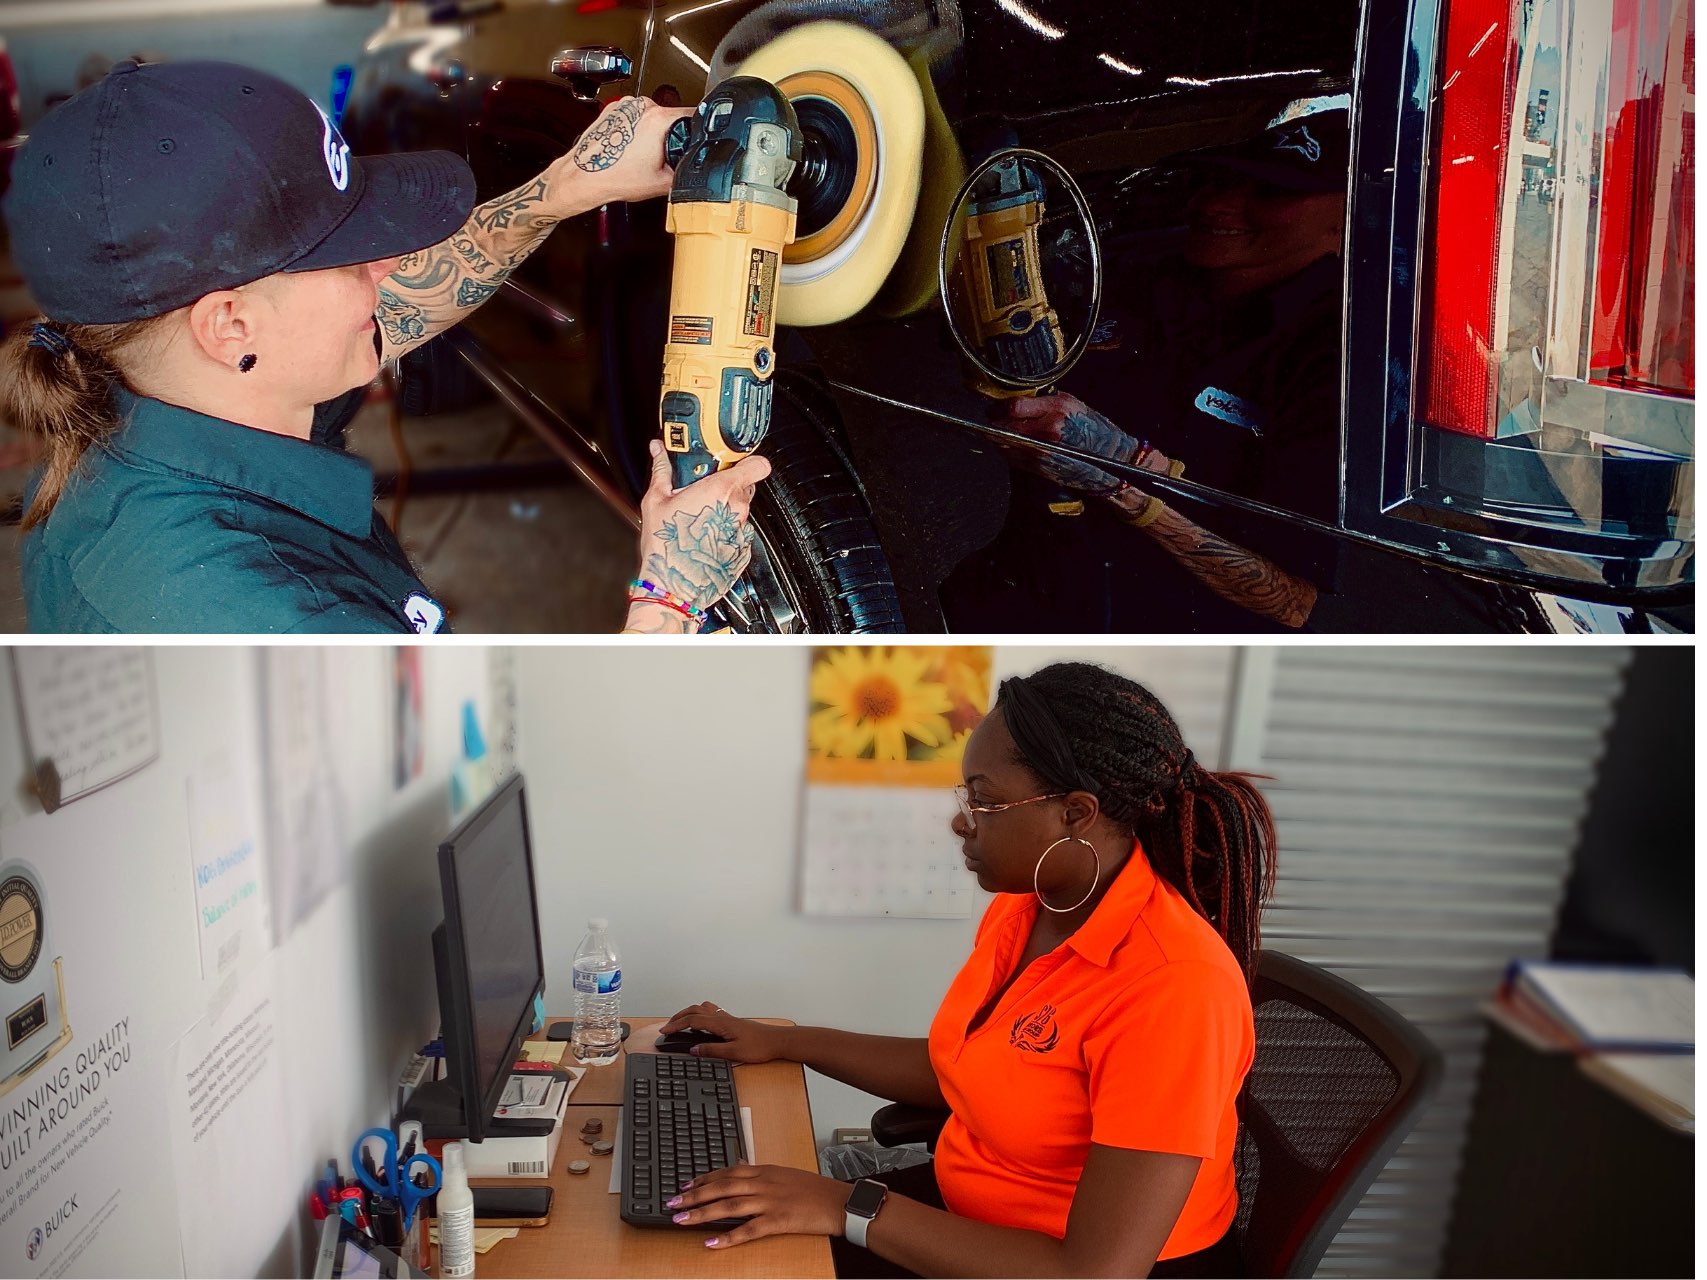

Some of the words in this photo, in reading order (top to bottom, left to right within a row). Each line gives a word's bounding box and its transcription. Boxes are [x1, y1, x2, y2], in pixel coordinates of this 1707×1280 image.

[76, 1016, 130, 1074] QUALITY
[1, 1127, 32, 1170] UILT
[39, 1070, 100, 1140] AROUND
[104, 1042, 131, 1078] YOU
[18, 1183, 39, 1206] Brand
[40, 1172, 51, 1188] for
[51, 1158, 66, 1176] New
[25, 1165, 37, 1182] the
[38, 1143, 62, 1169] owners
[44, 1193, 79, 1238] BUICK
